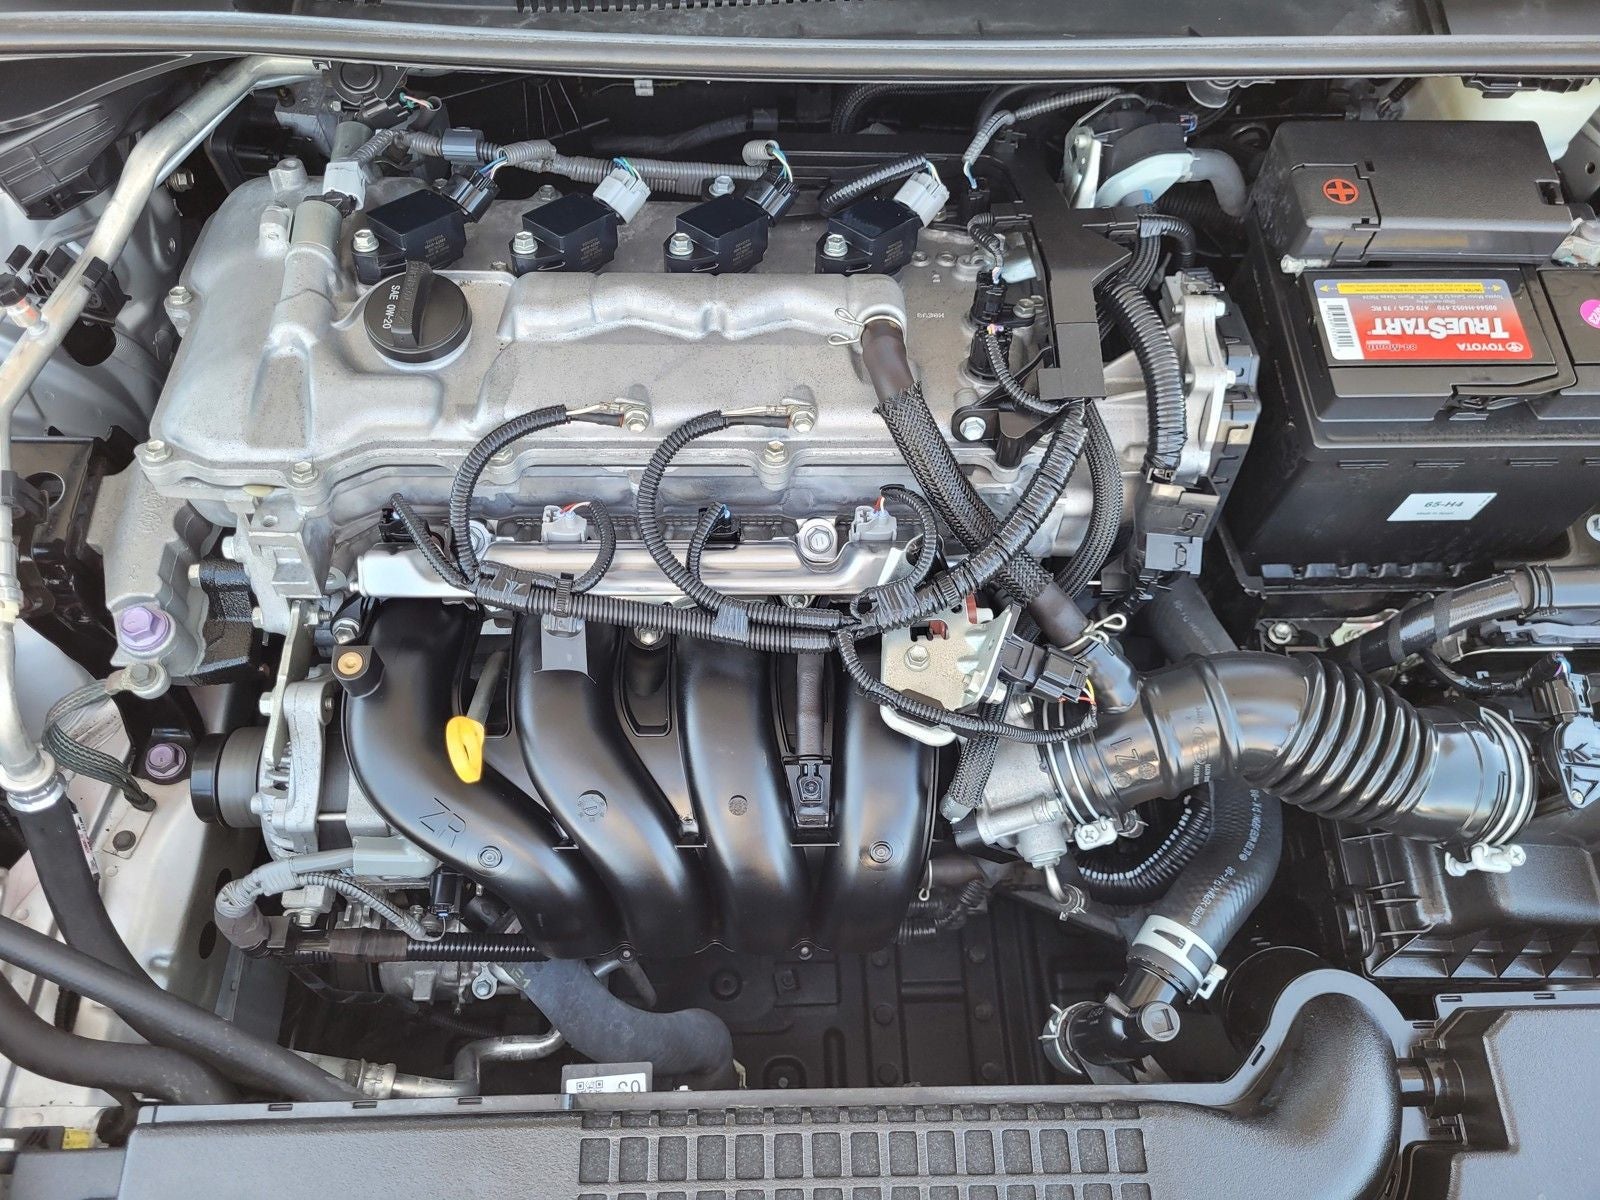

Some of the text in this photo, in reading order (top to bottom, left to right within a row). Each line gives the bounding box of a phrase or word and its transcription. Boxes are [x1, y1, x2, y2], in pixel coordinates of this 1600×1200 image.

[382, 284, 400, 329] SAE 0W-20
[1456, 343, 1505, 351] TOYOTA
